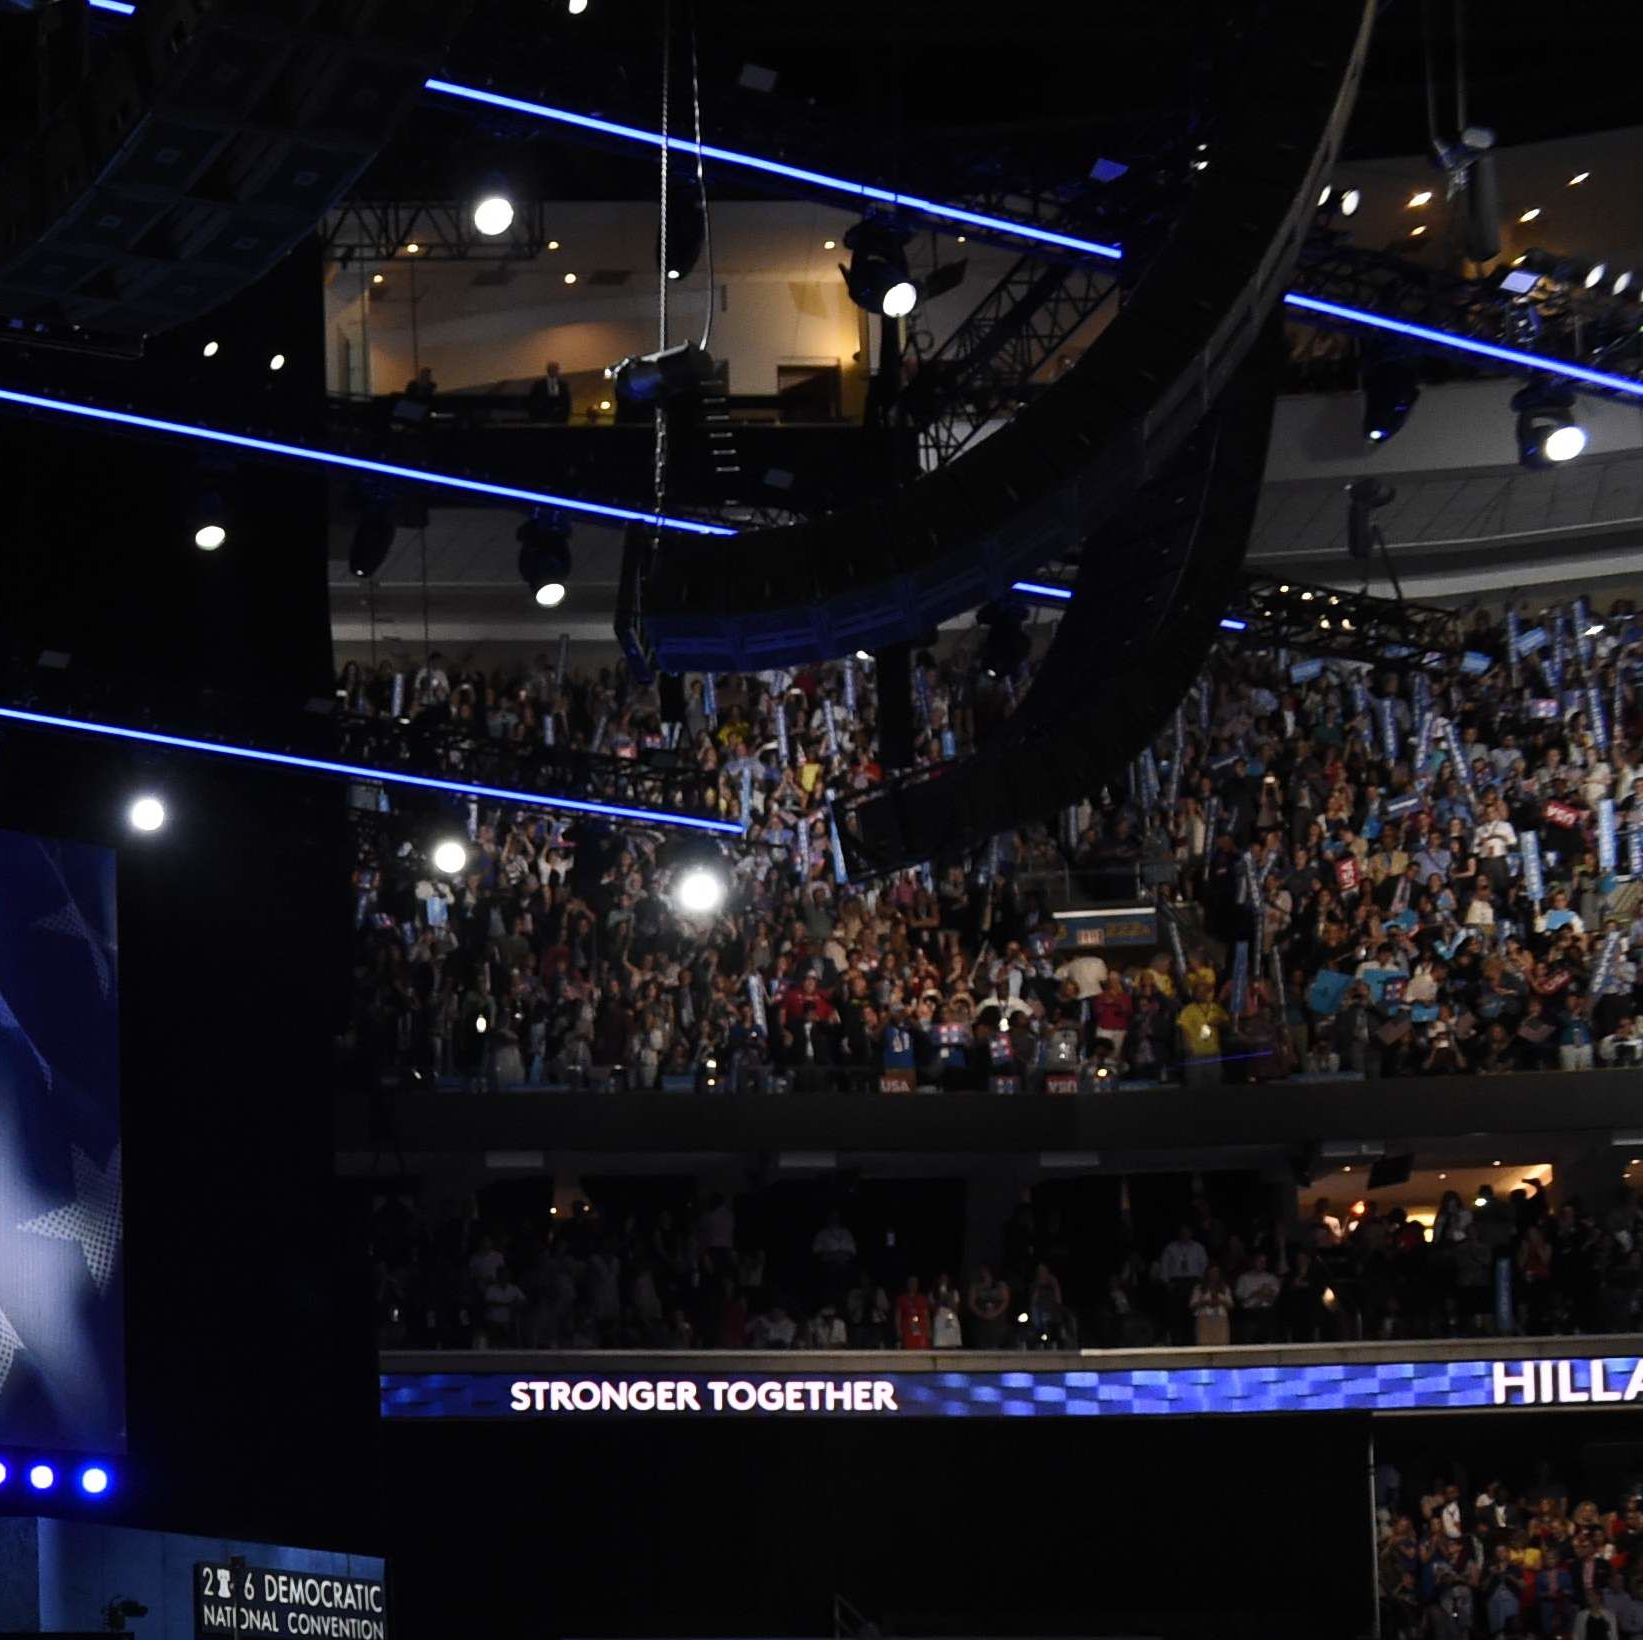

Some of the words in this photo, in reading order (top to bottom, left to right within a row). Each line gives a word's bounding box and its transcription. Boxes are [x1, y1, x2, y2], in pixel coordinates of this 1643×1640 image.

[510, 1379, 699, 1412] STRONGER
[707, 1380, 897, 1411] TOGETHER
[264, 1574, 383, 1613] DEMOCRATIC
[287, 1612, 384, 1640] CONVENTION
